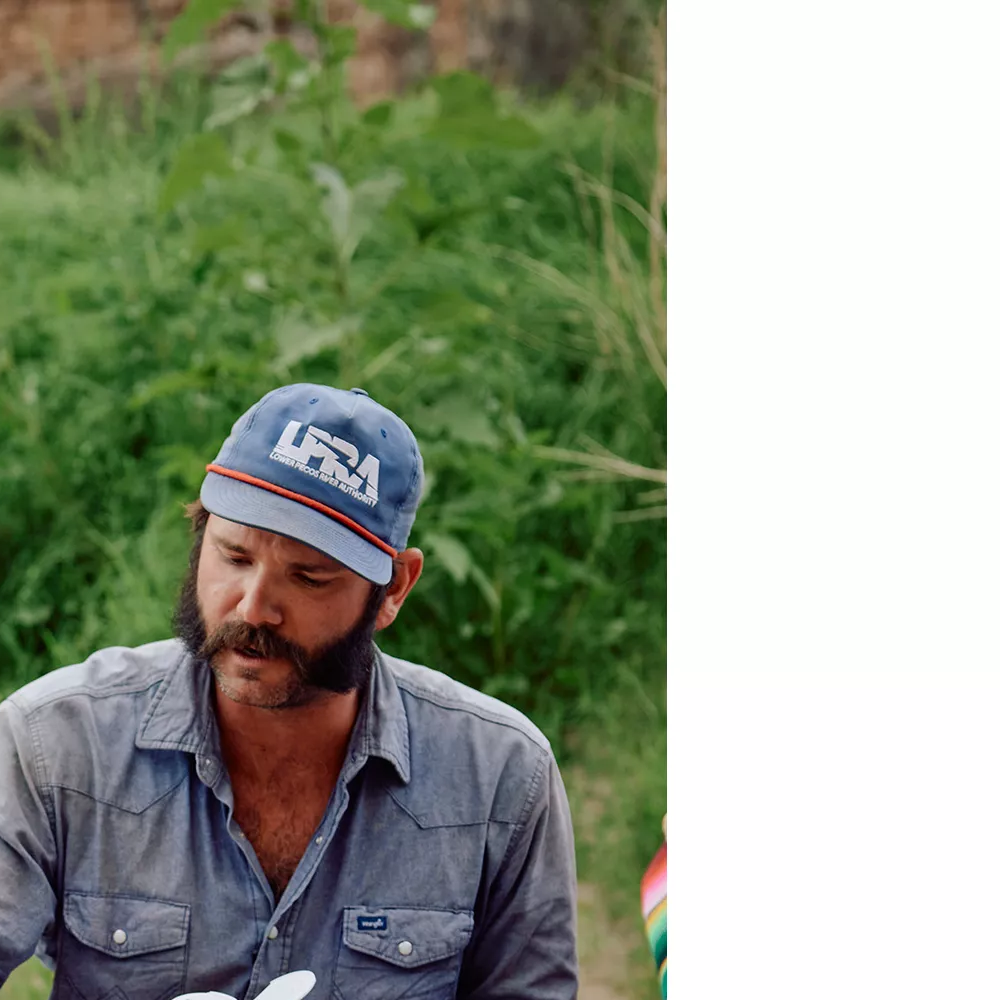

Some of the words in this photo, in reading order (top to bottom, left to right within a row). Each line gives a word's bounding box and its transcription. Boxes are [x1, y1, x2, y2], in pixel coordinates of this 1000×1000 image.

[269, 452, 295, 467] LOWER
[294, 463, 320, 478] PECOS
[319, 471, 340, 488] RIVER
[338, 482, 378, 508] AUTHORITY
